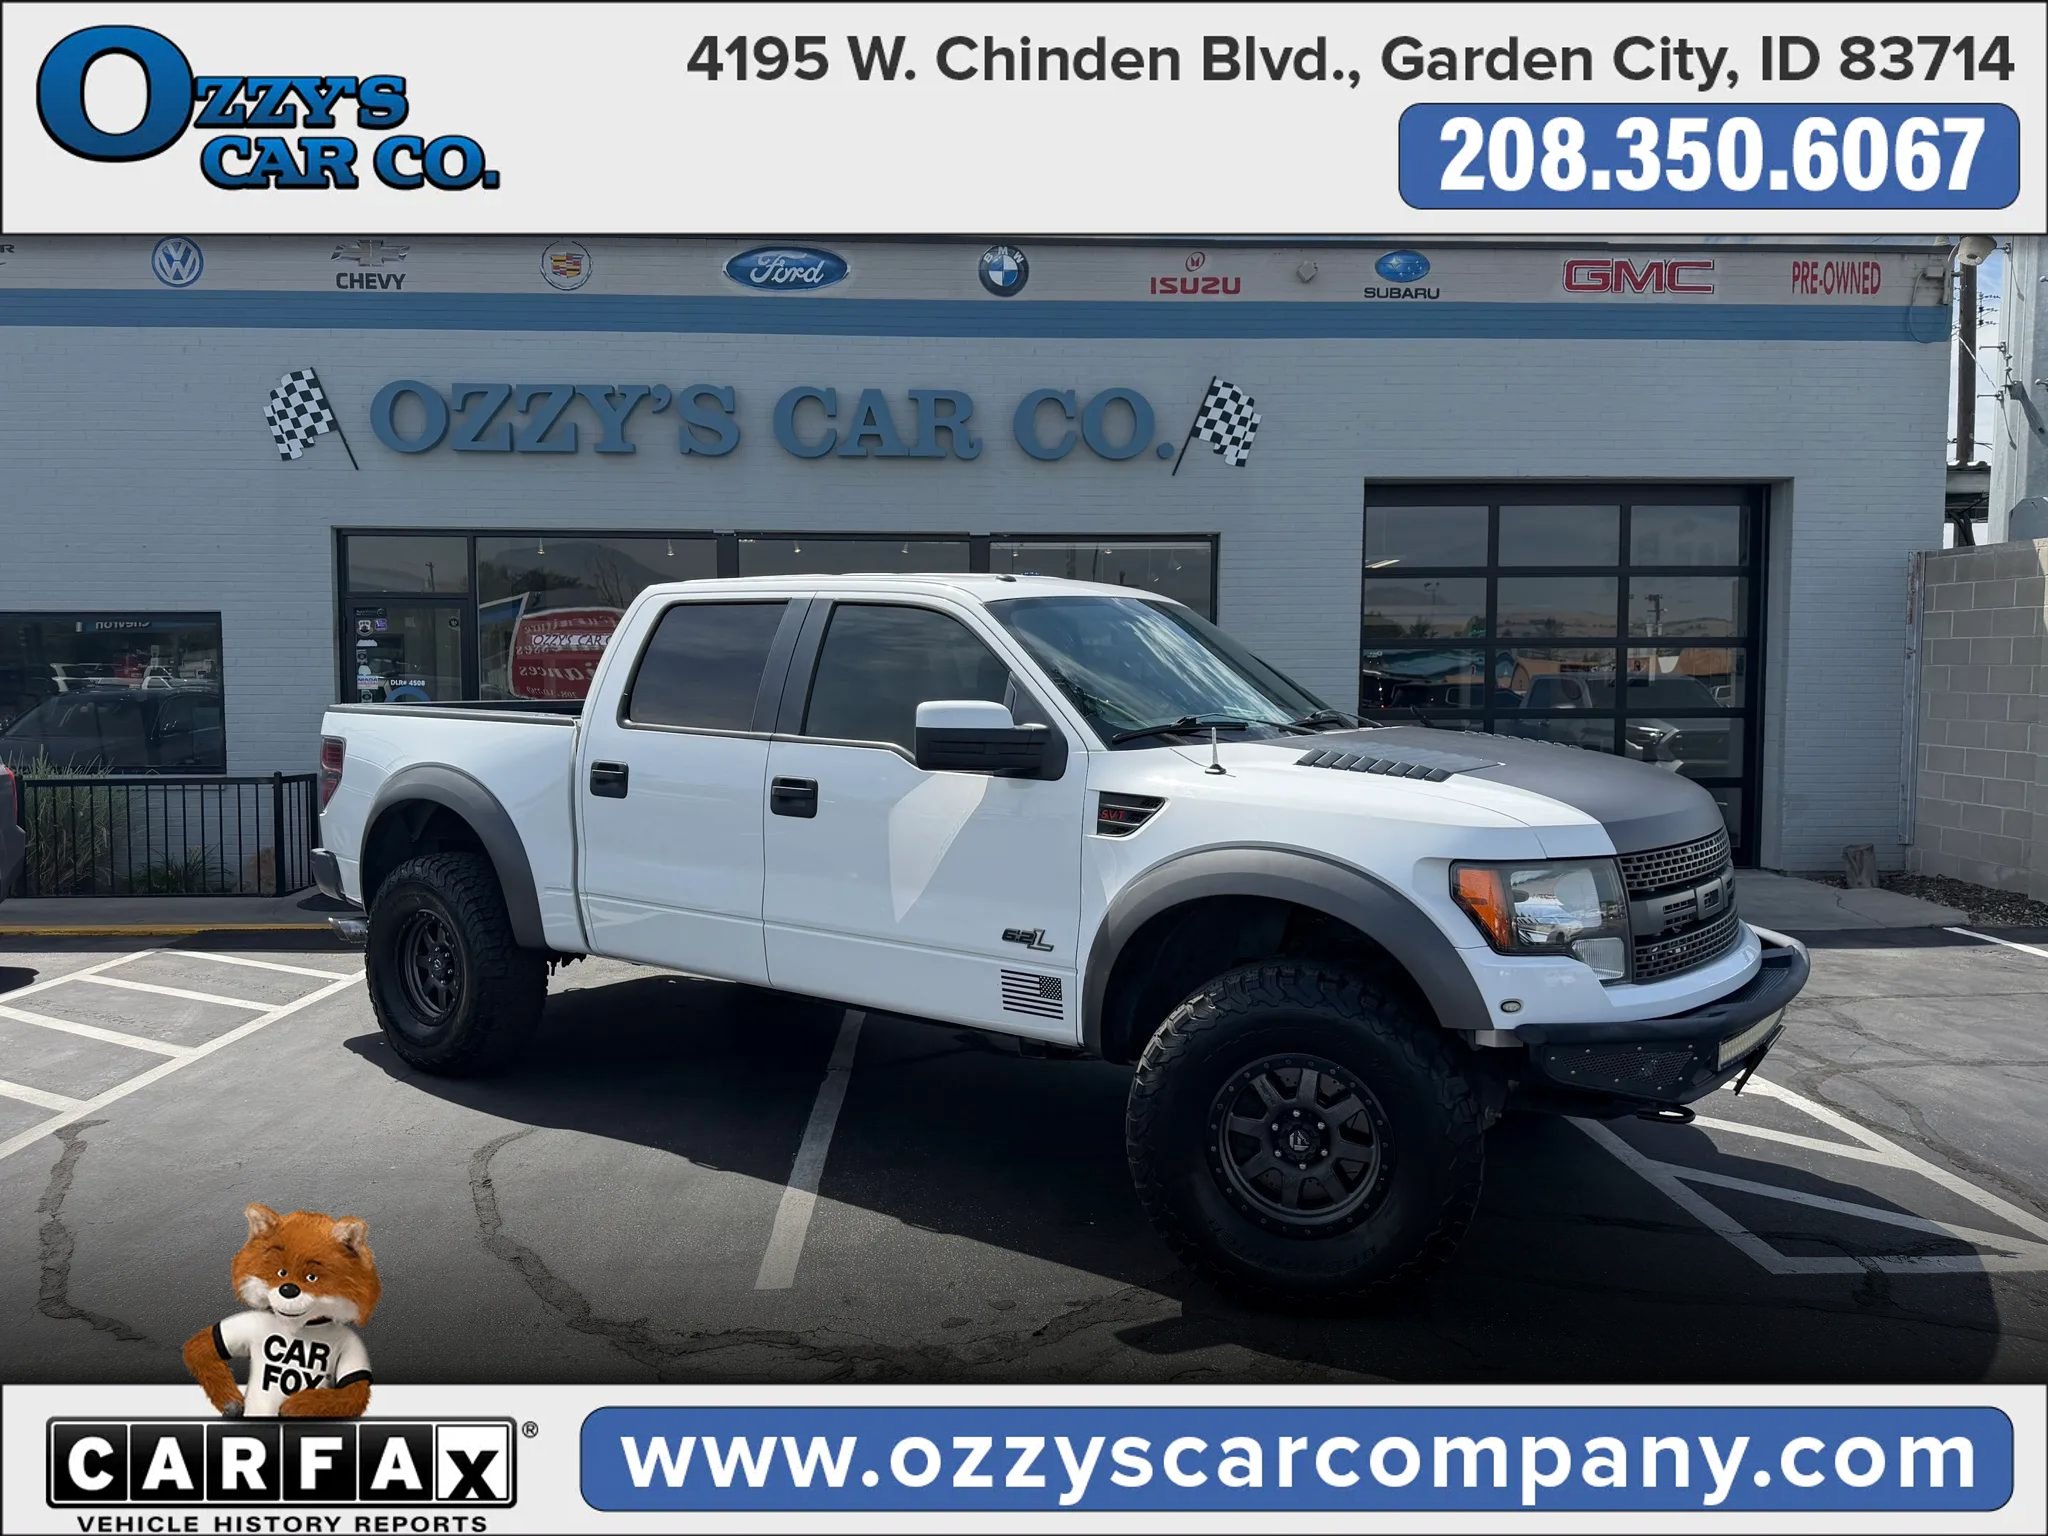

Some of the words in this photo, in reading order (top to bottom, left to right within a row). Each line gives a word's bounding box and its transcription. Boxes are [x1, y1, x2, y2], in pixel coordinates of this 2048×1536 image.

[983, 246, 1024, 263] BMW
[749, 251, 824, 283] Ford
[1563, 258, 1714, 294] GMC
[335, 272, 406, 291] CHEVY
[1150, 276, 1241, 295] ISUZU
[1792, 260, 1881, 295] PRE-OWNED
[1363, 287, 1440, 300] SUBARU
[370, 379, 741, 456] OZZY'S
[773, 386, 983, 460] CAR
[1013, 387, 1175, 460] CO.
[534, 634, 573, 646] OZZY'S
[578, 634, 602, 646] CAR
[1101, 809, 1127, 820] SVT
[1002, 928, 1054, 952] 6.2L
